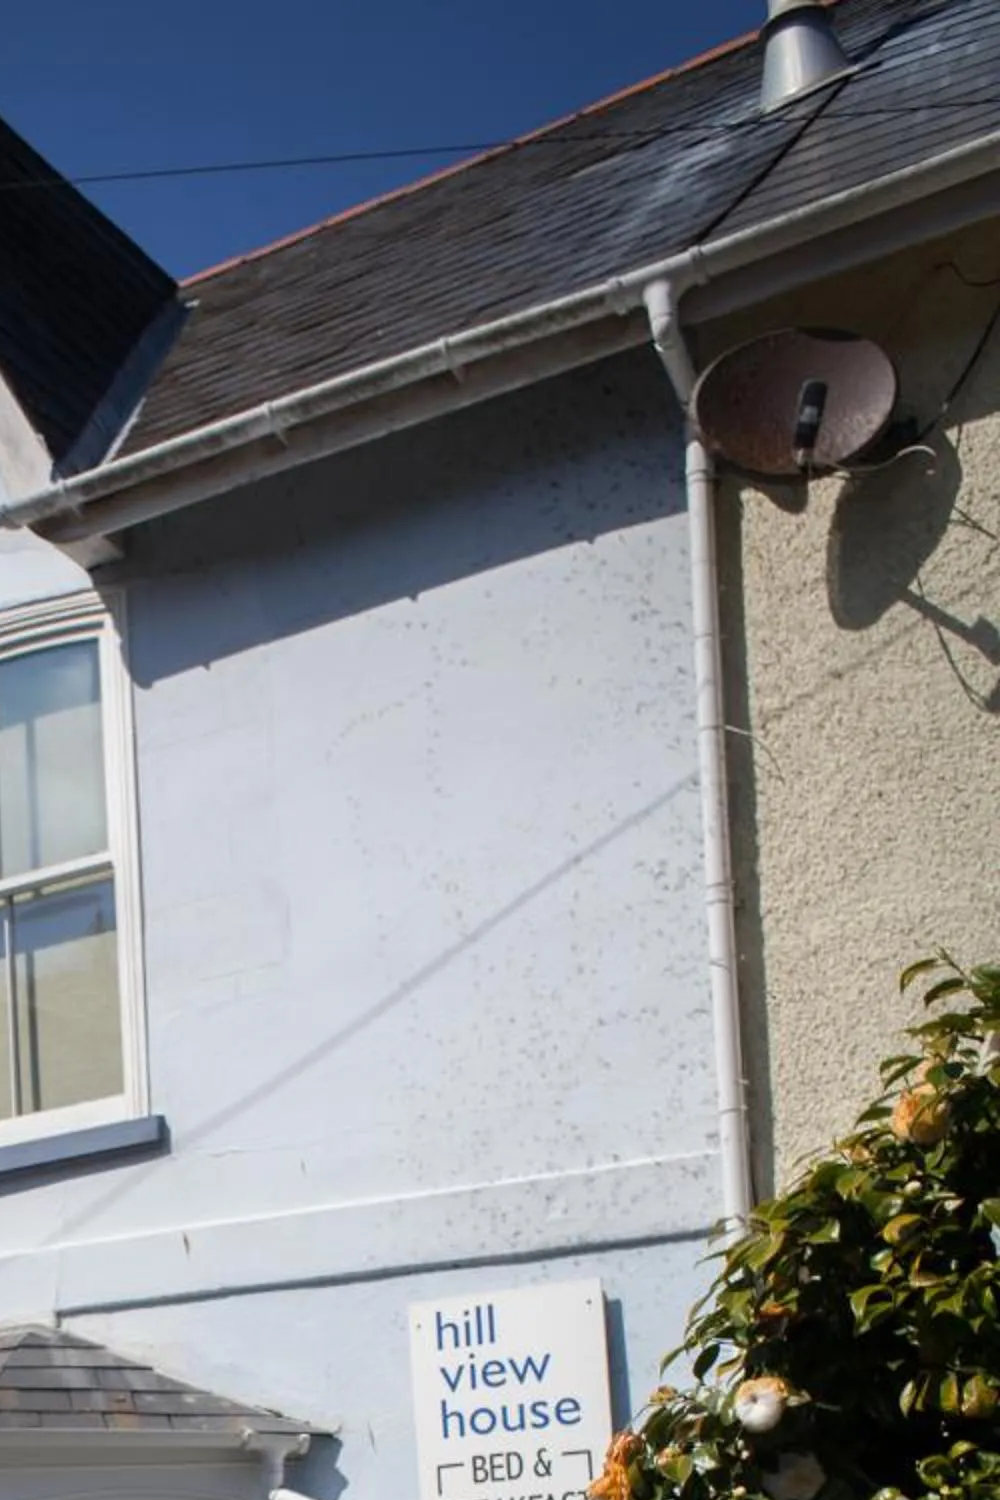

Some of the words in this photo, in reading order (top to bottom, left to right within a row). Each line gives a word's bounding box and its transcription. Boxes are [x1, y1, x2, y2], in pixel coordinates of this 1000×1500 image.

[435, 1303, 496, 1350] hill
[440, 1353, 551, 1393] view
[440, 1397, 582, 1439] house
[471, 1451, 524, 1484] BED
[533, 1447, 553, 1478] &
